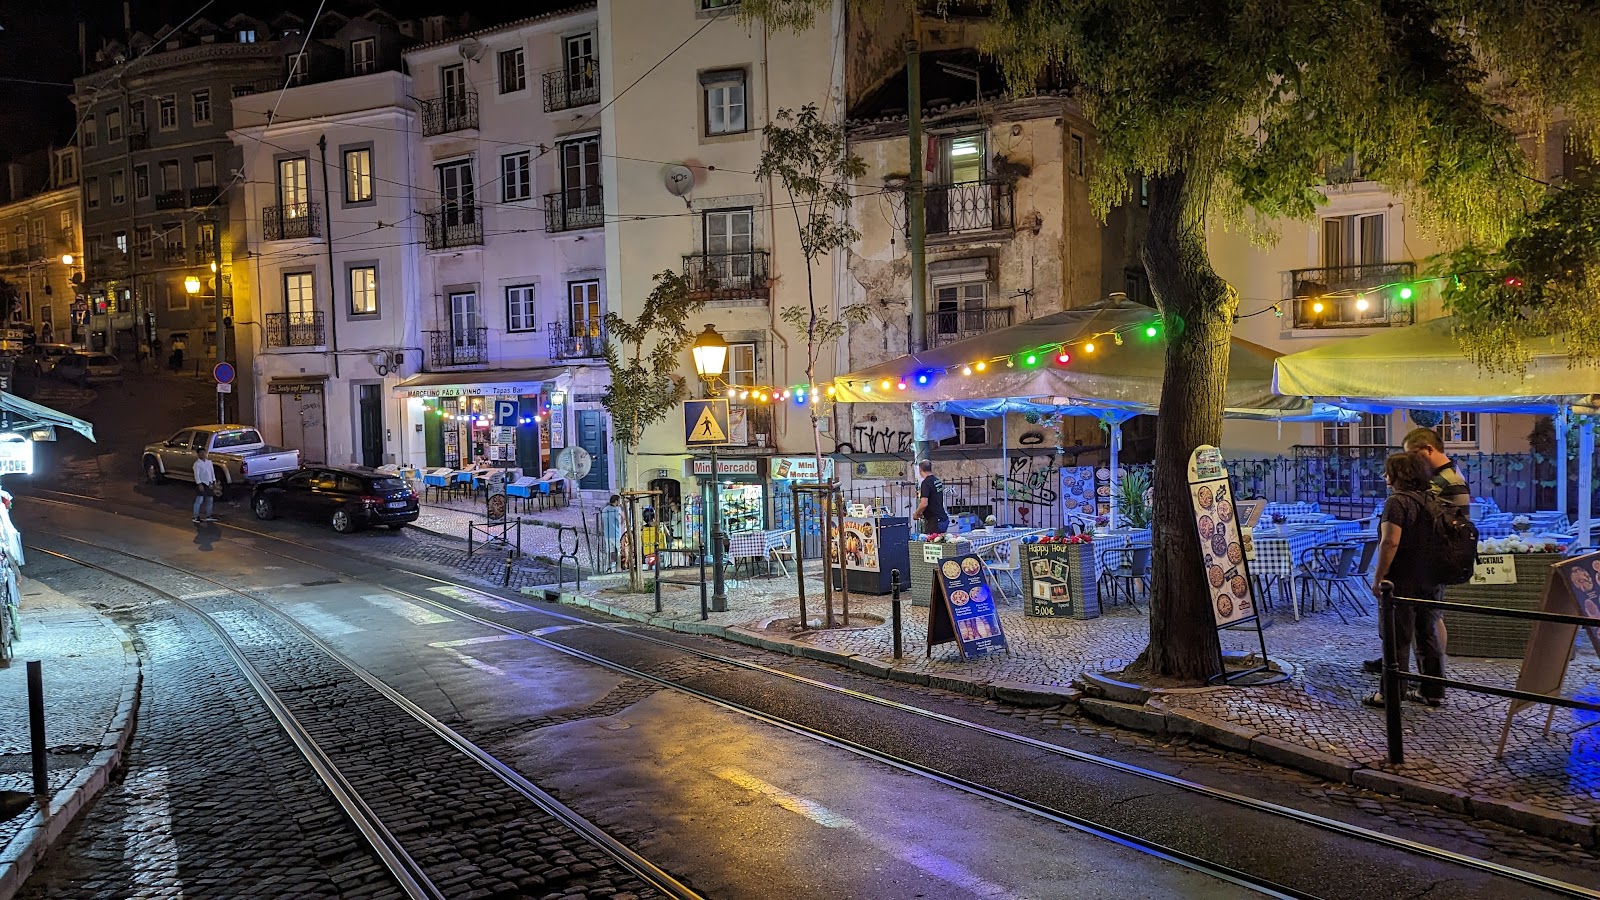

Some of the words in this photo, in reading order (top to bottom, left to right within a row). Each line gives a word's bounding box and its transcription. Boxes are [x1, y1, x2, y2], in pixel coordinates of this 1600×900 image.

[671, 173, 687, 182] NOS
[493, 387, 511, 396] Tapas
[498, 402, 514, 425] P
[716, 462, 756, 472] Mercado
[1028, 544, 1049, 556] Happy
[1051, 544, 1067, 553] Hour
[1479, 556, 1504, 564] OCKTAILS
